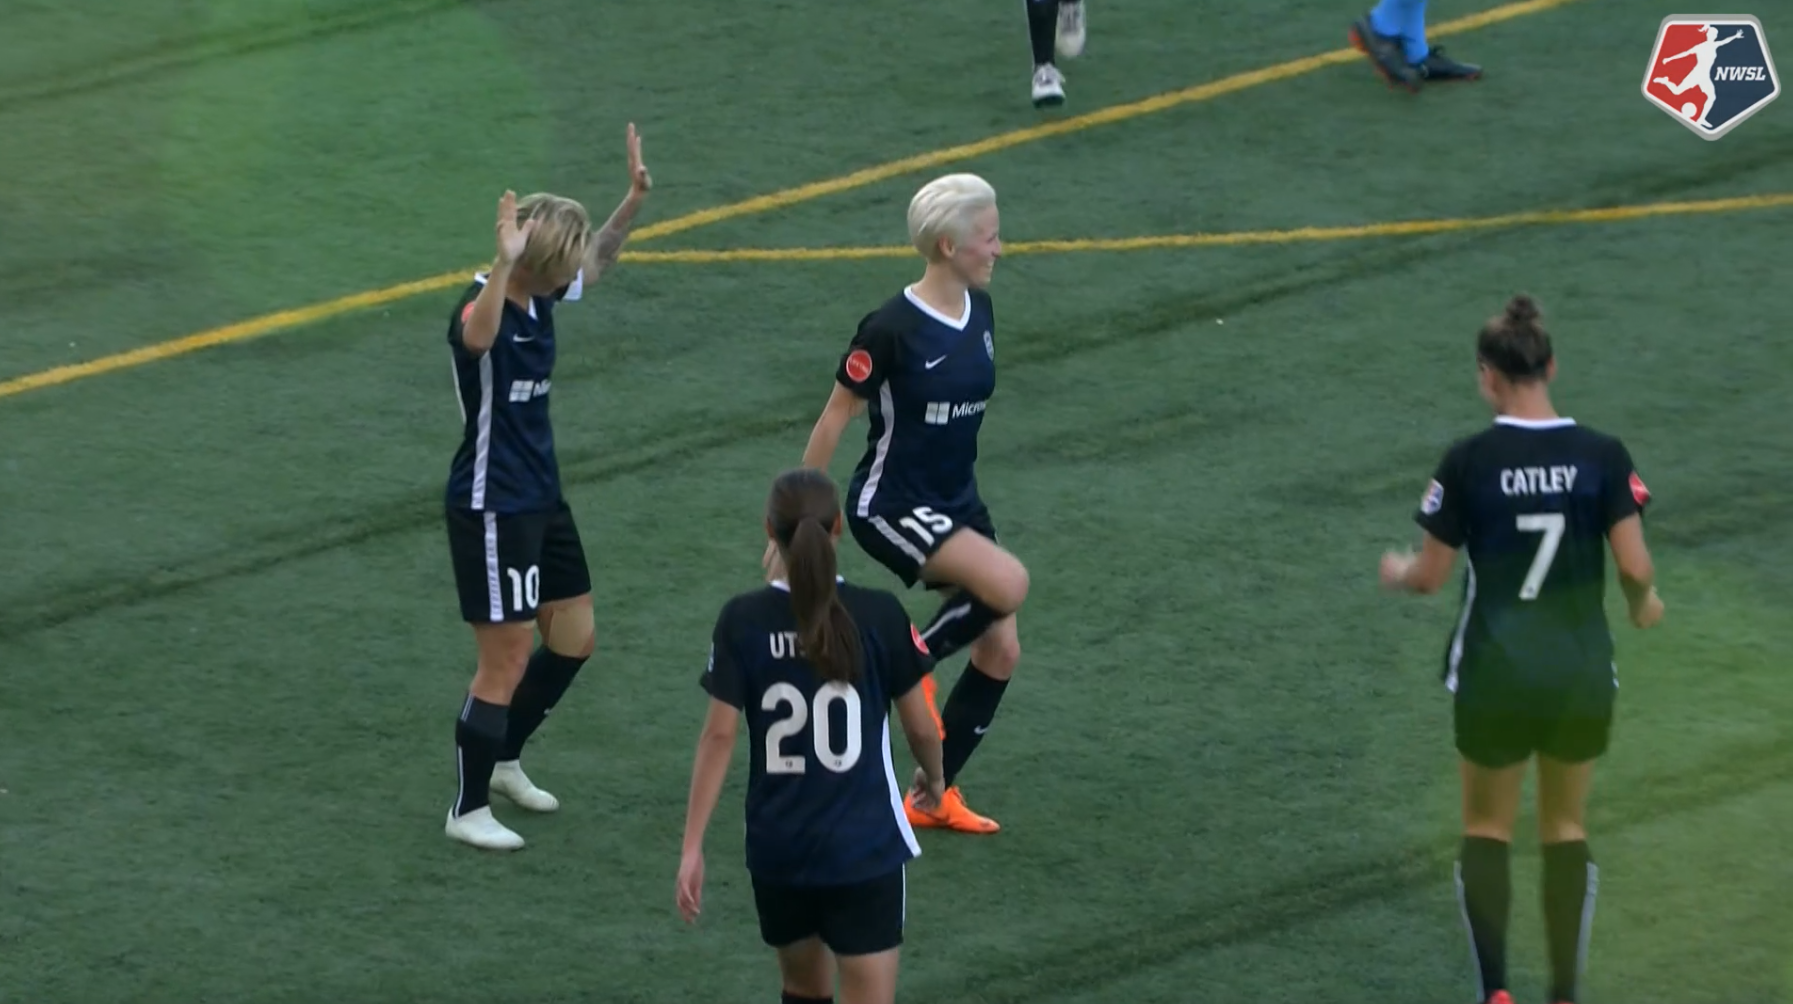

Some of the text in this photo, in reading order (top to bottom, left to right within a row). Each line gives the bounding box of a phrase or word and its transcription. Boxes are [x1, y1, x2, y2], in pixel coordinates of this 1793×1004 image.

[1500, 465, 1578, 496] CATLEY
[899, 506, 953, 547] 15
[1515, 512, 1566, 601] 7
[507, 565, 540, 611] 10
[761, 680, 862, 774] 20
